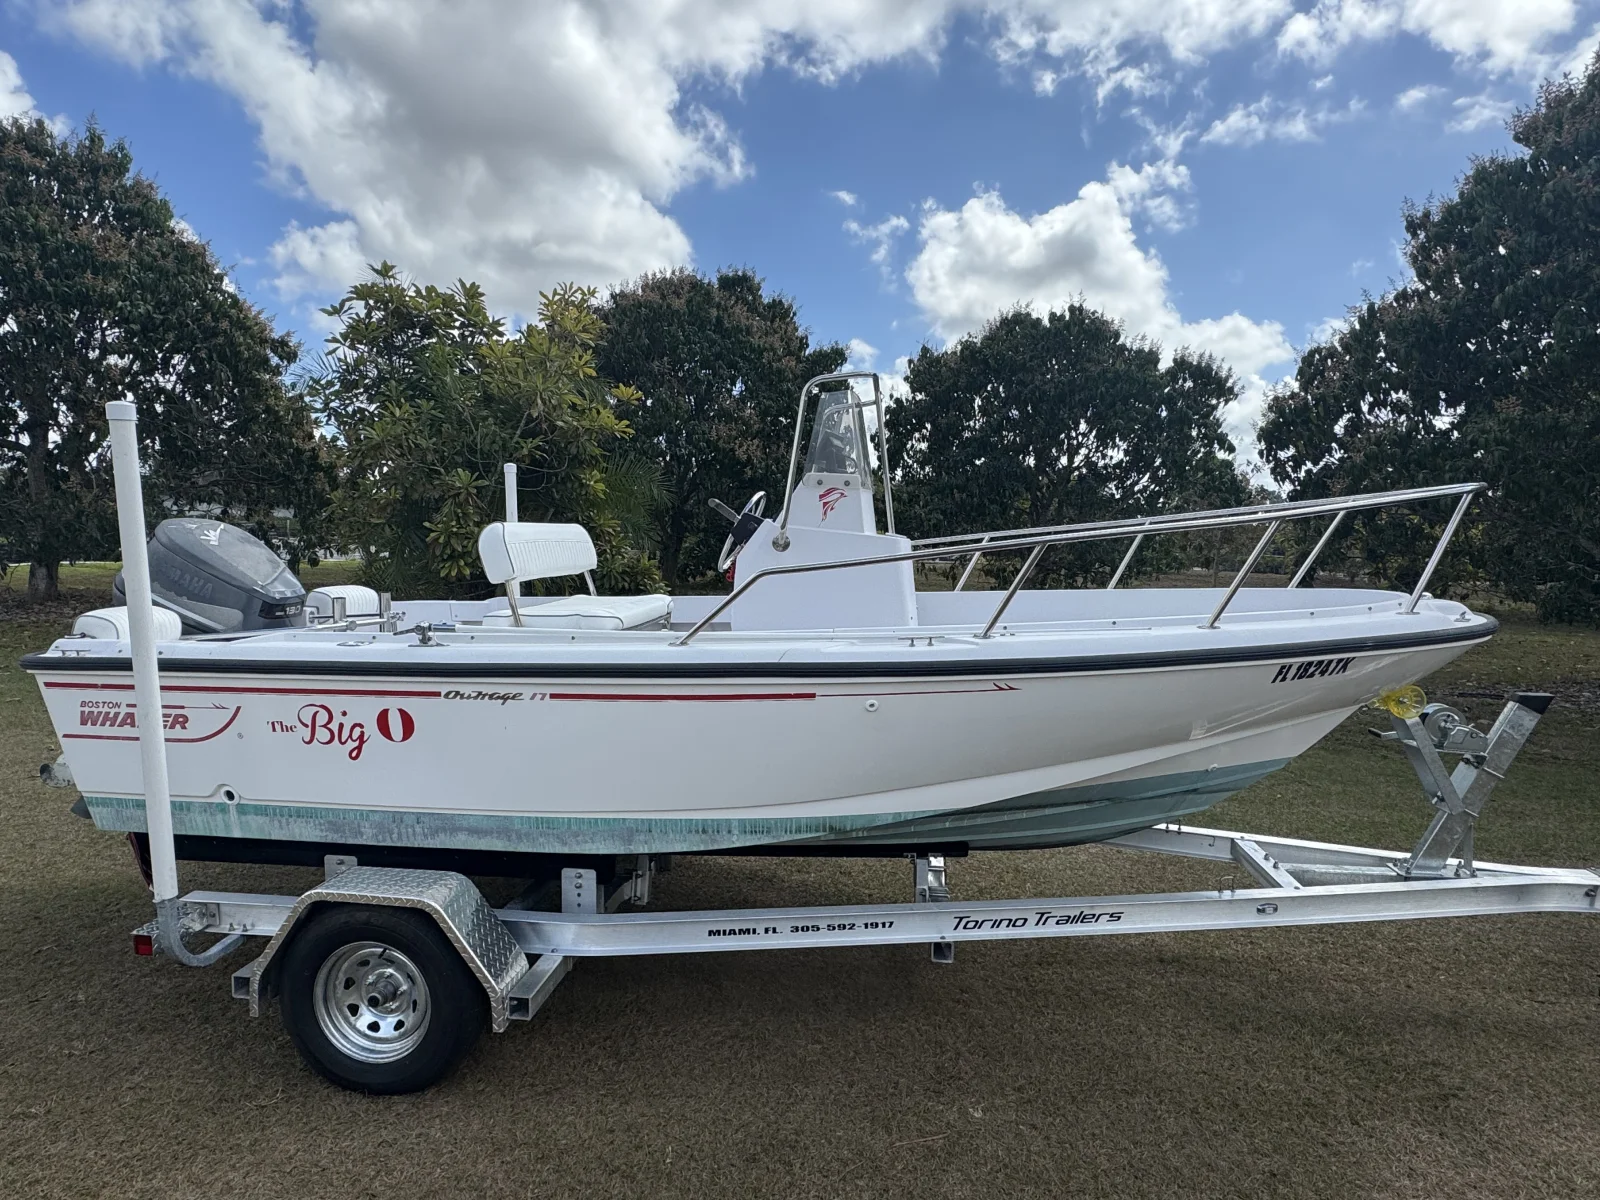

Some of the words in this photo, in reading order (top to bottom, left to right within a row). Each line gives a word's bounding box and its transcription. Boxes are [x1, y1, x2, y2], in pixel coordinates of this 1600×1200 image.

[1271, 663, 1293, 683] FL
[80, 701, 121, 709] BOSTON
[443, 690, 524, 705] Outrage
[529, 692, 547, 701] 17
[80, 710, 189, 730] WHAER
[267, 720, 297, 733] The
[297, 703, 371, 761] Big
[376, 707, 415, 743] O
[790, 921, 894, 934] 305-592-1917
[953, 915, 1028, 931] Torino
[1034, 911, 1124, 927] Trailers
